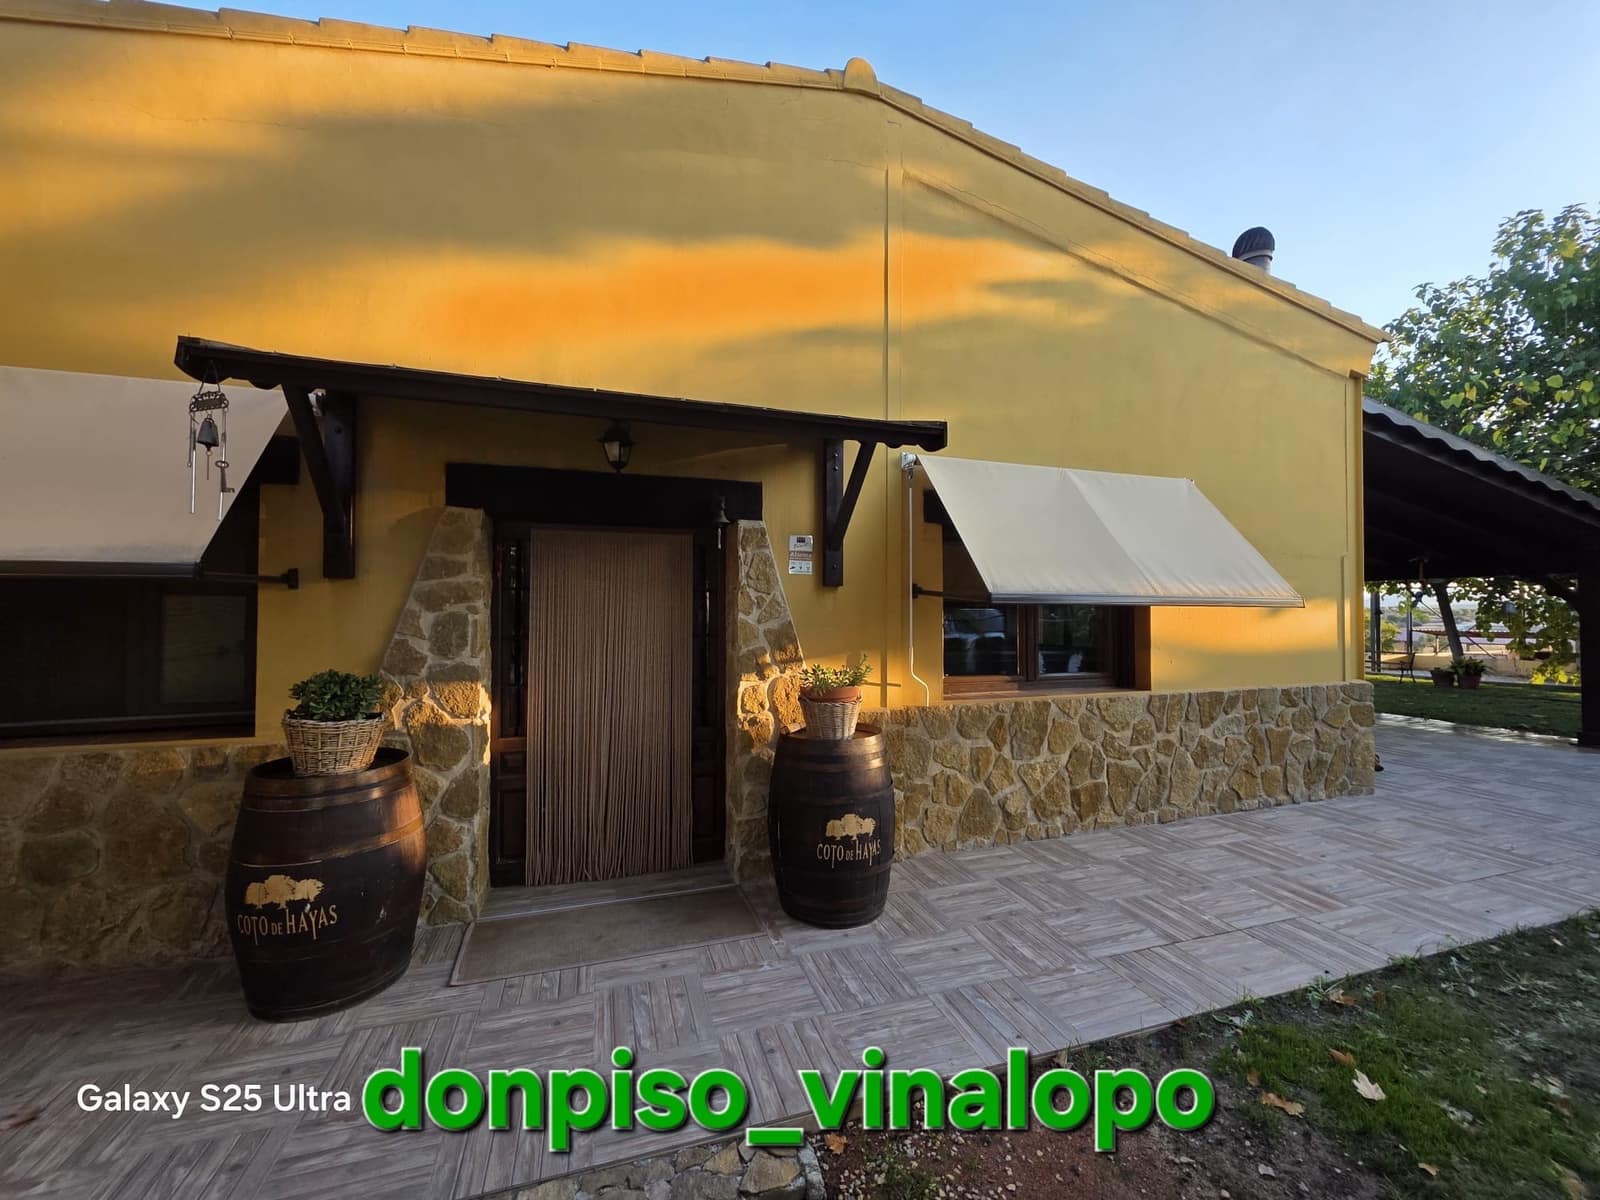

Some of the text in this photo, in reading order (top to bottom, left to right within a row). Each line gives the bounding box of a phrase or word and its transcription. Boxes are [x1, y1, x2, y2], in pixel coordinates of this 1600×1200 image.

[816, 839, 881, 869] COTO DE HAYAS
[237, 904, 338, 946] COTO DE HAYAS
